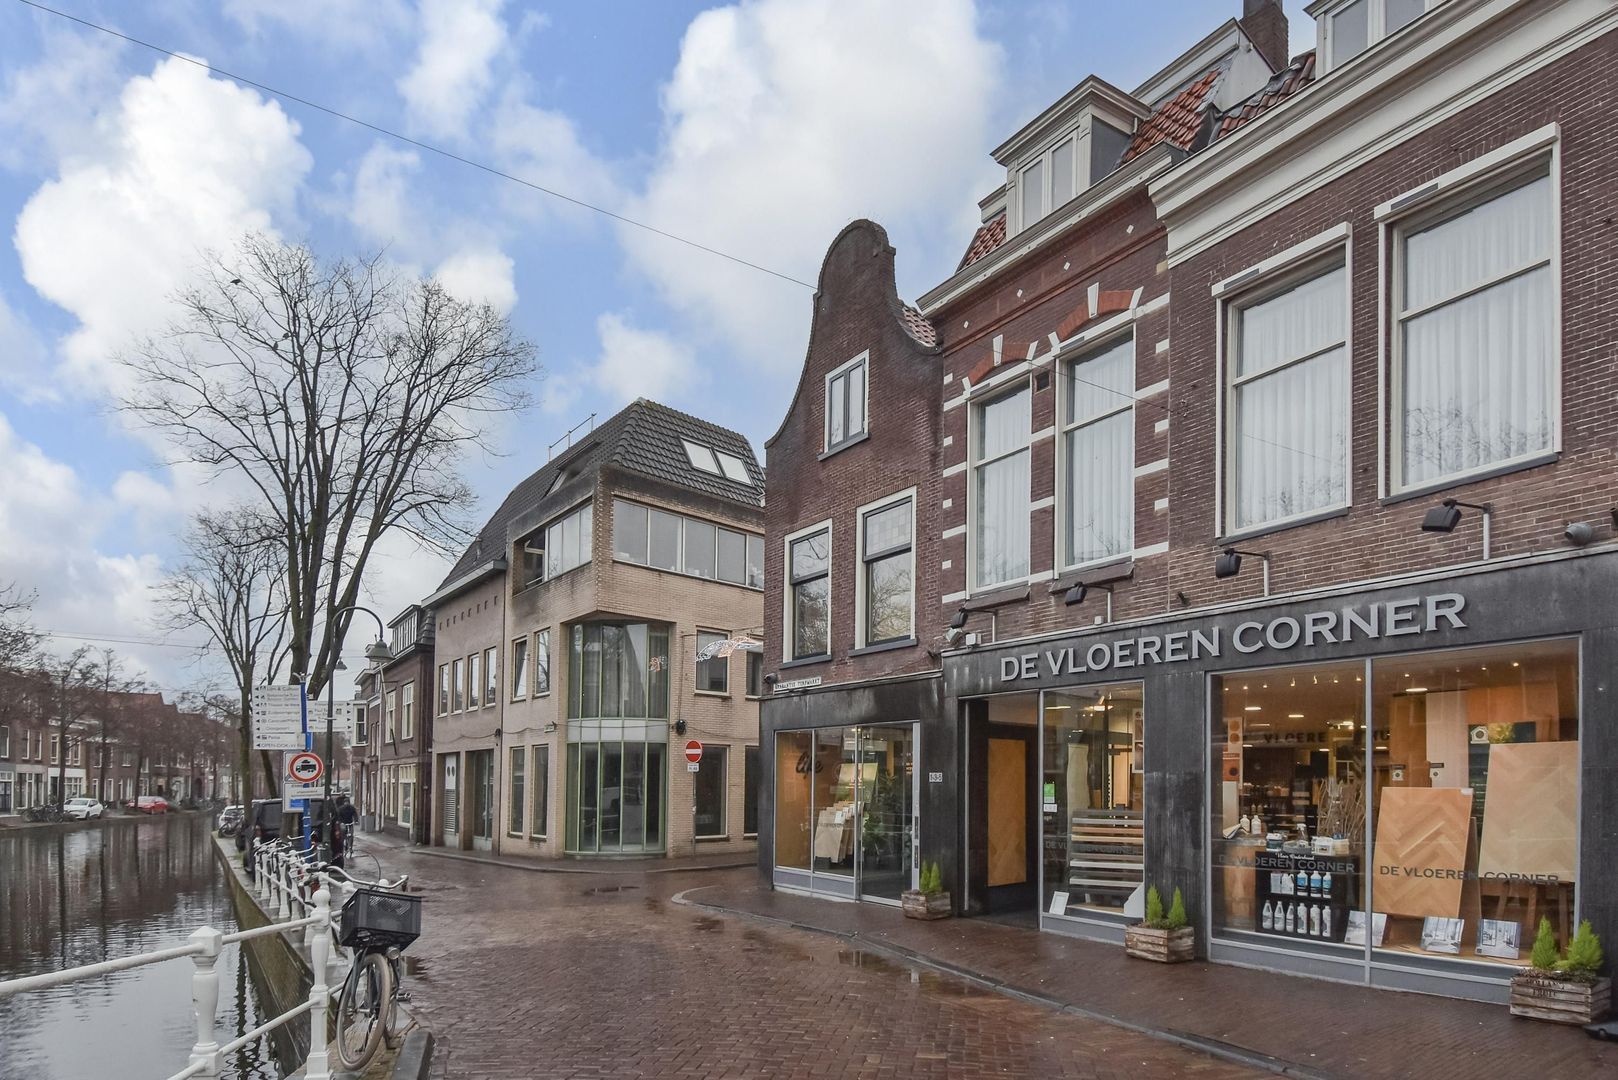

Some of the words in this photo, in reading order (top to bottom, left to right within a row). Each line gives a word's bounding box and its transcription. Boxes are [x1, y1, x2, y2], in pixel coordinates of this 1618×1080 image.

[1000, 652, 1039, 682] DE
[1046, 626, 1221, 677] VLOEREN
[1233, 592, 1467, 655] CORNER
[1297, 860, 1355, 873] CORNER
[1380, 865, 1399, 876] DE
[1484, 872, 1559, 885] CORNER
